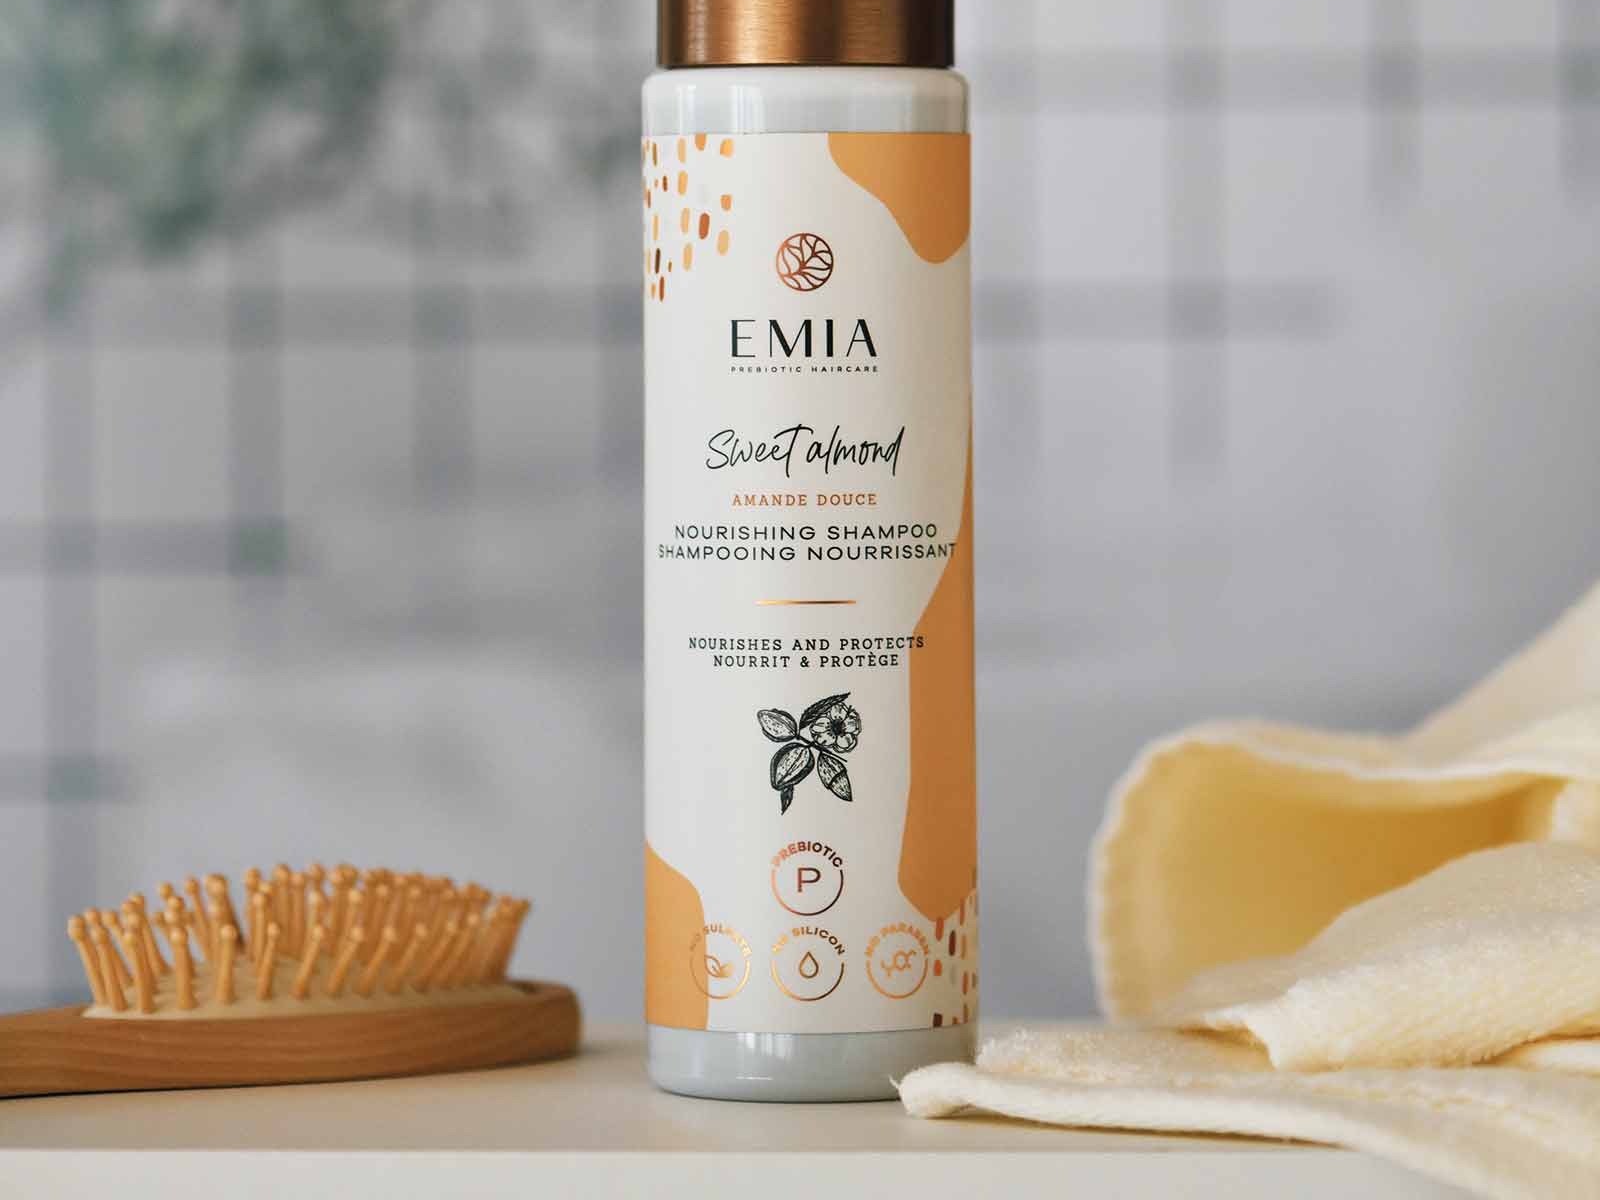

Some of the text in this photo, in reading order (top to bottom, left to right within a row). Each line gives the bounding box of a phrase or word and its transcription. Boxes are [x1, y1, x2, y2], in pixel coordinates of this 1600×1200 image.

[731, 319, 877, 358] EMIA
[806, 425, 905, 476] almond
[732, 493, 877, 506] AMANDE DOUCE
[675, 523, 937, 540] NOURISHING SHAMPOO
[658, 543, 956, 560] SHAMPOOING NOURRISSANT
[689, 636, 925, 650] NOURISHES AND PROTECTS
[713, 651, 899, 668] NOURRIT & PROTÈGE
[771, 841, 844, 867] PREBIOTIC
[797, 867, 821, 893] P
[791, 926, 846, 955] SILICON
